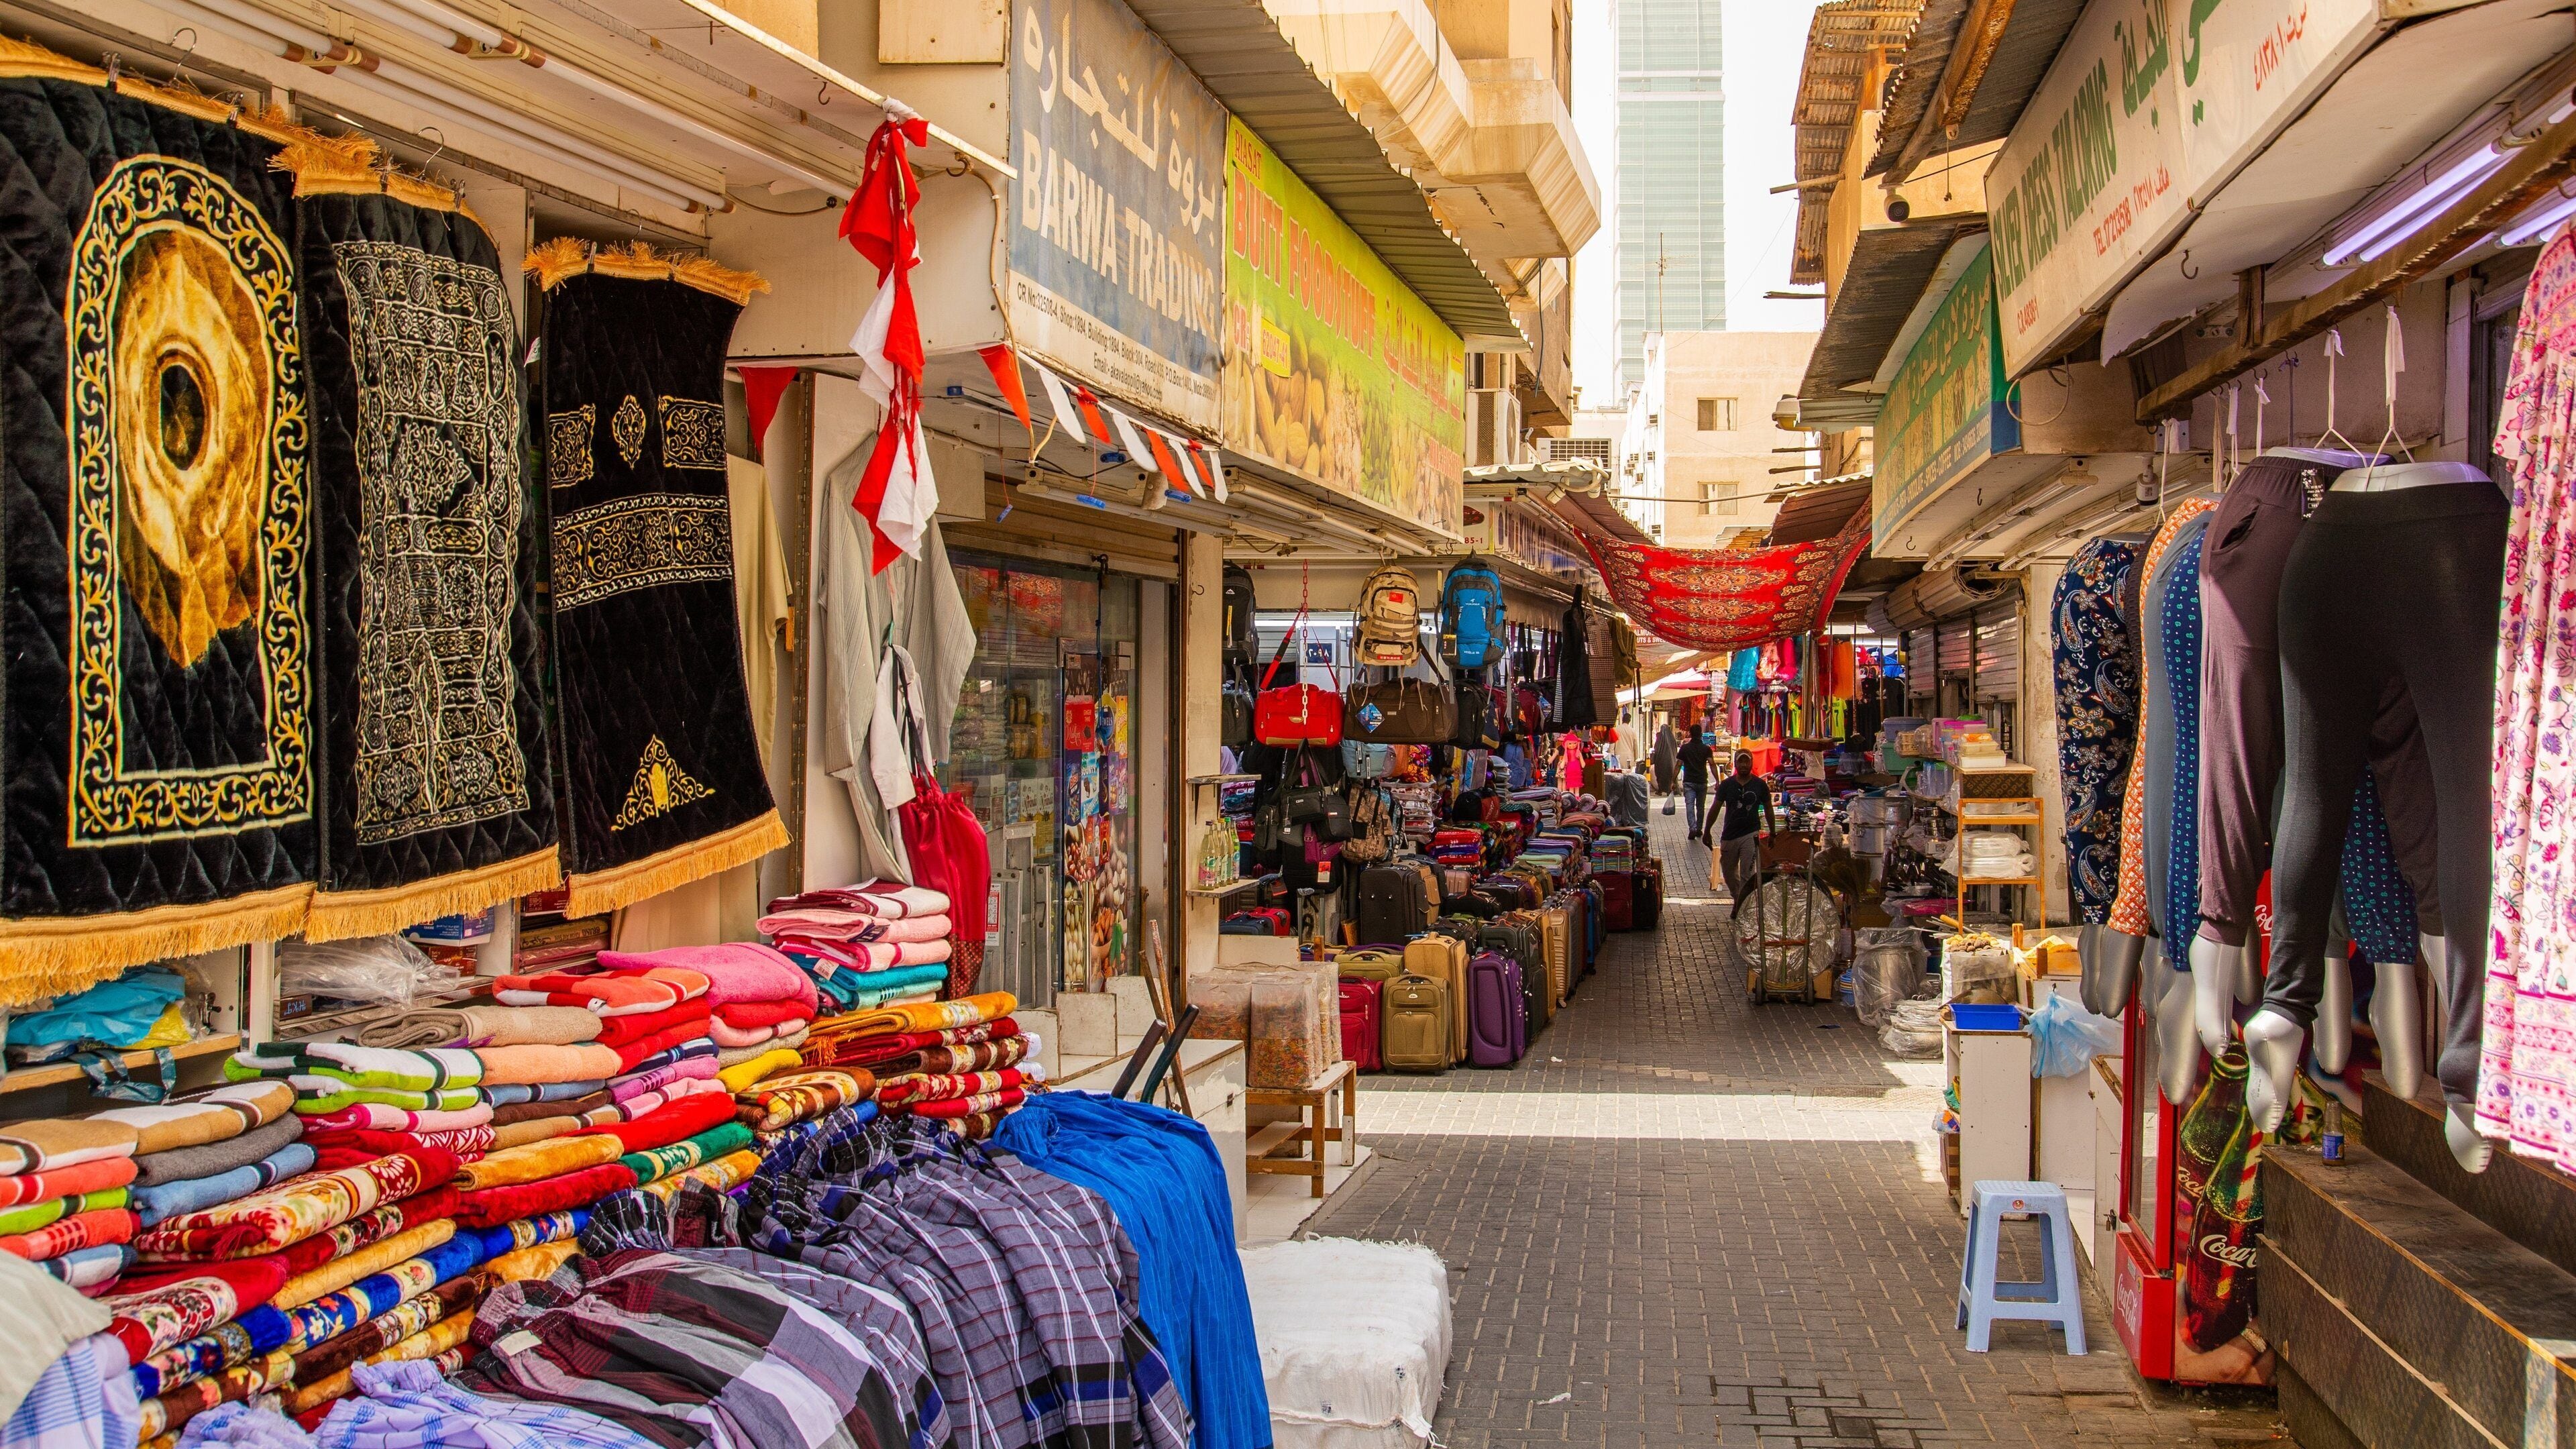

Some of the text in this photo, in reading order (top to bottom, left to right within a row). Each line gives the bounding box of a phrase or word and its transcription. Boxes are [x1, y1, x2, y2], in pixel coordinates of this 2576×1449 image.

[1169, 109, 1216, 247] بروة
[1234, 129, 1262, 180] RIASAT
[1994, 58, 2116, 303] SILVER DRESS TAILORING
[1018, 282, 1026, 303] CR
[1022, 129, 1216, 339] BARWA TRADING
[1232, 166, 1376, 360] BUTT FOODSTUFF
[1834, 709, 1839, 727] 7
